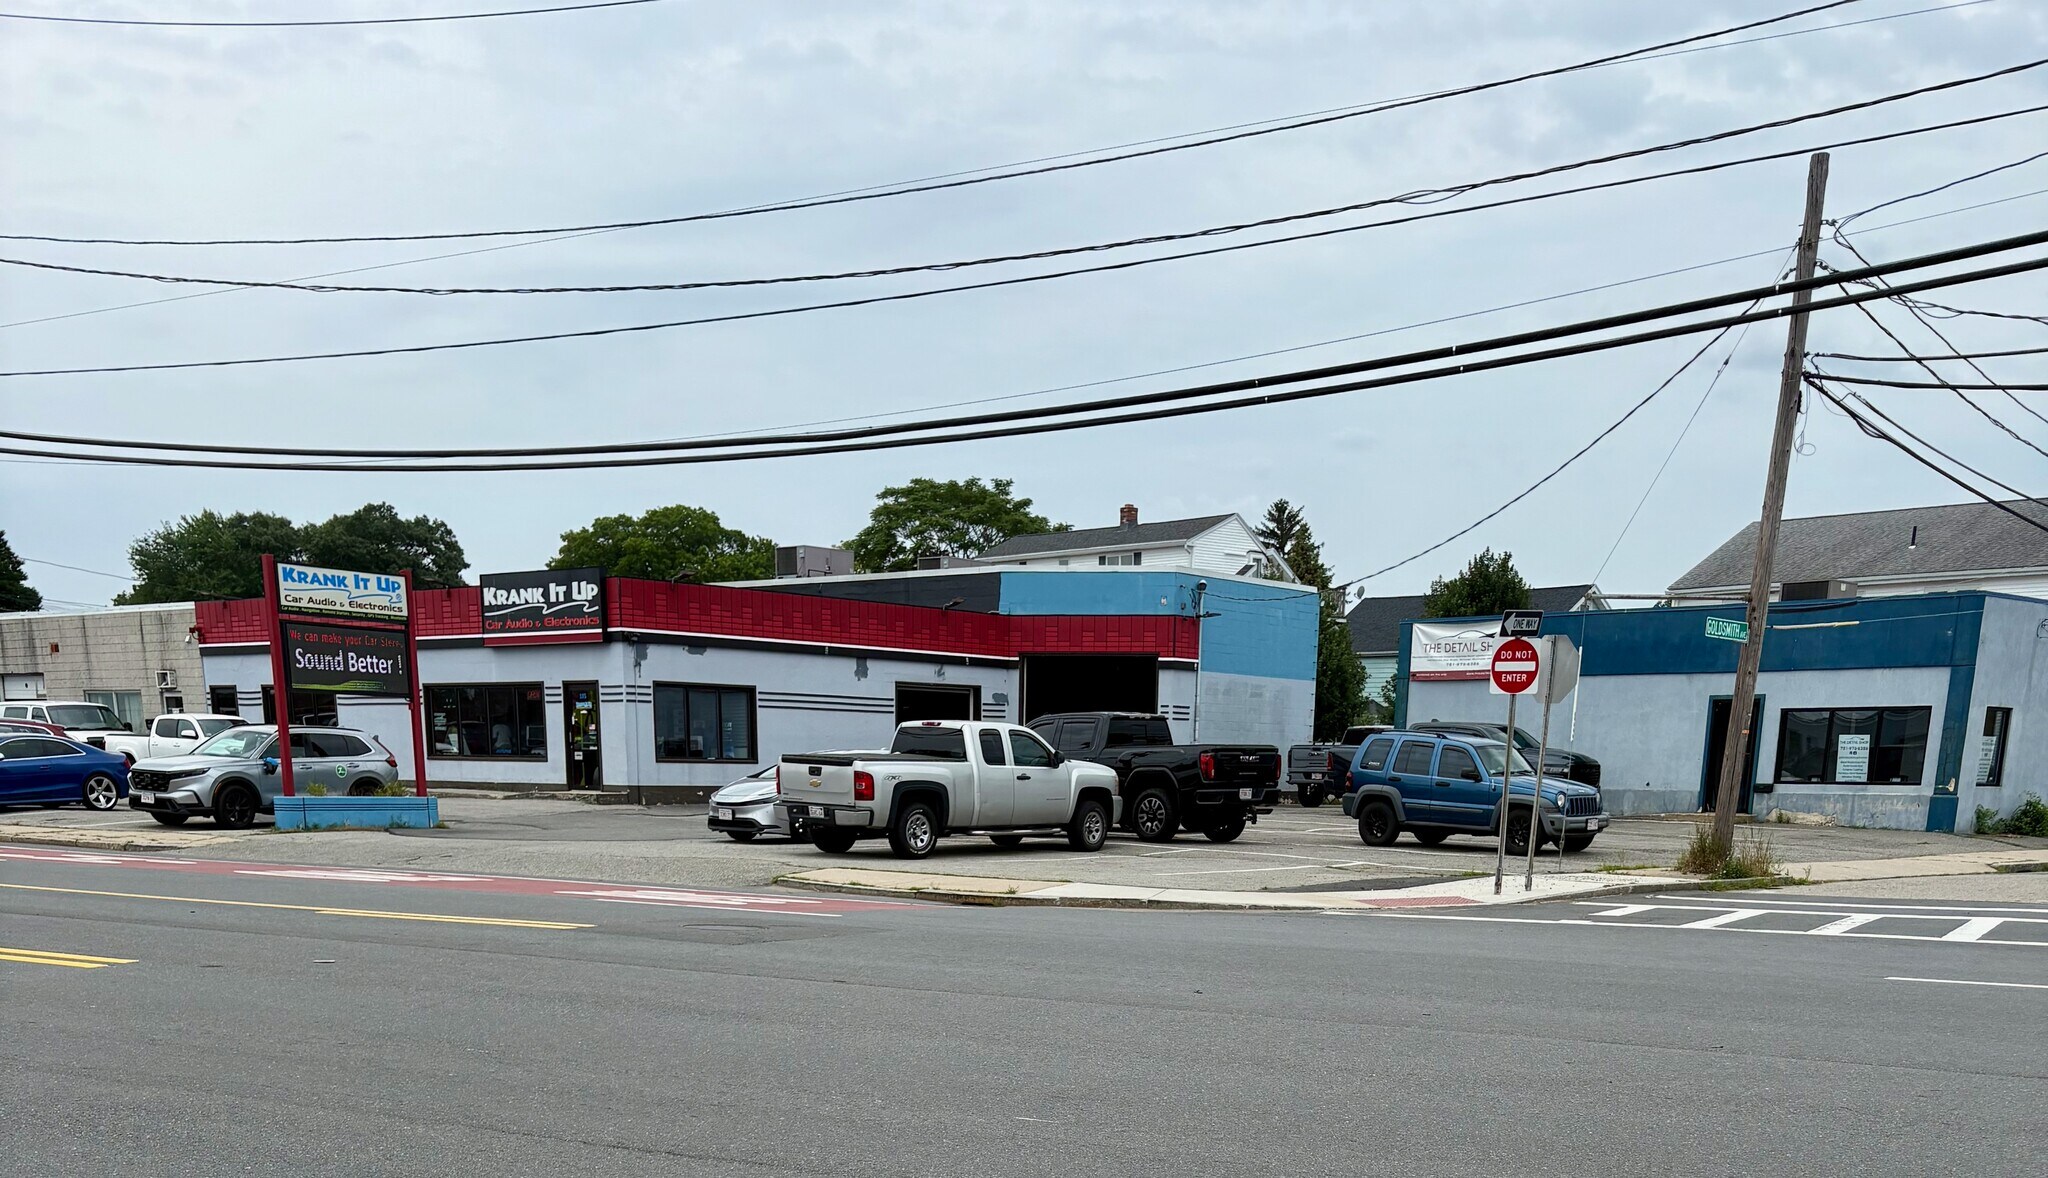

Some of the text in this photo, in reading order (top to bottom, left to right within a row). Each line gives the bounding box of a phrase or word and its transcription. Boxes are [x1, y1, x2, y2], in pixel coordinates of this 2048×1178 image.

[281, 567, 401, 593] KRANK IT UP
[483, 580, 599, 605] KRANK IT UP
[284, 594, 303, 603] Car
[307, 596, 337, 607] Audio
[348, 600, 403, 613] Electronics
[486, 620, 502, 630] Car
[505, 618, 533, 629] Audio
[544, 615, 599, 627] Electronics
[1513, 619, 1537, 629] ONE WAY
[1708, 620, 1740, 637] GOLDSMITH
[289, 629, 301, 640] We
[304, 633, 318, 642] can
[1424, 643, 1442, 653] THE
[1444, 642, 1477, 653] DETAIL
[1501, 651, 1512, 659] DO
[1515, 650, 1532, 659] NOT
[295, 648, 344, 671] Sound
[347, 652, 393, 674] Better
[1502, 673, 1527, 682] ENTER
